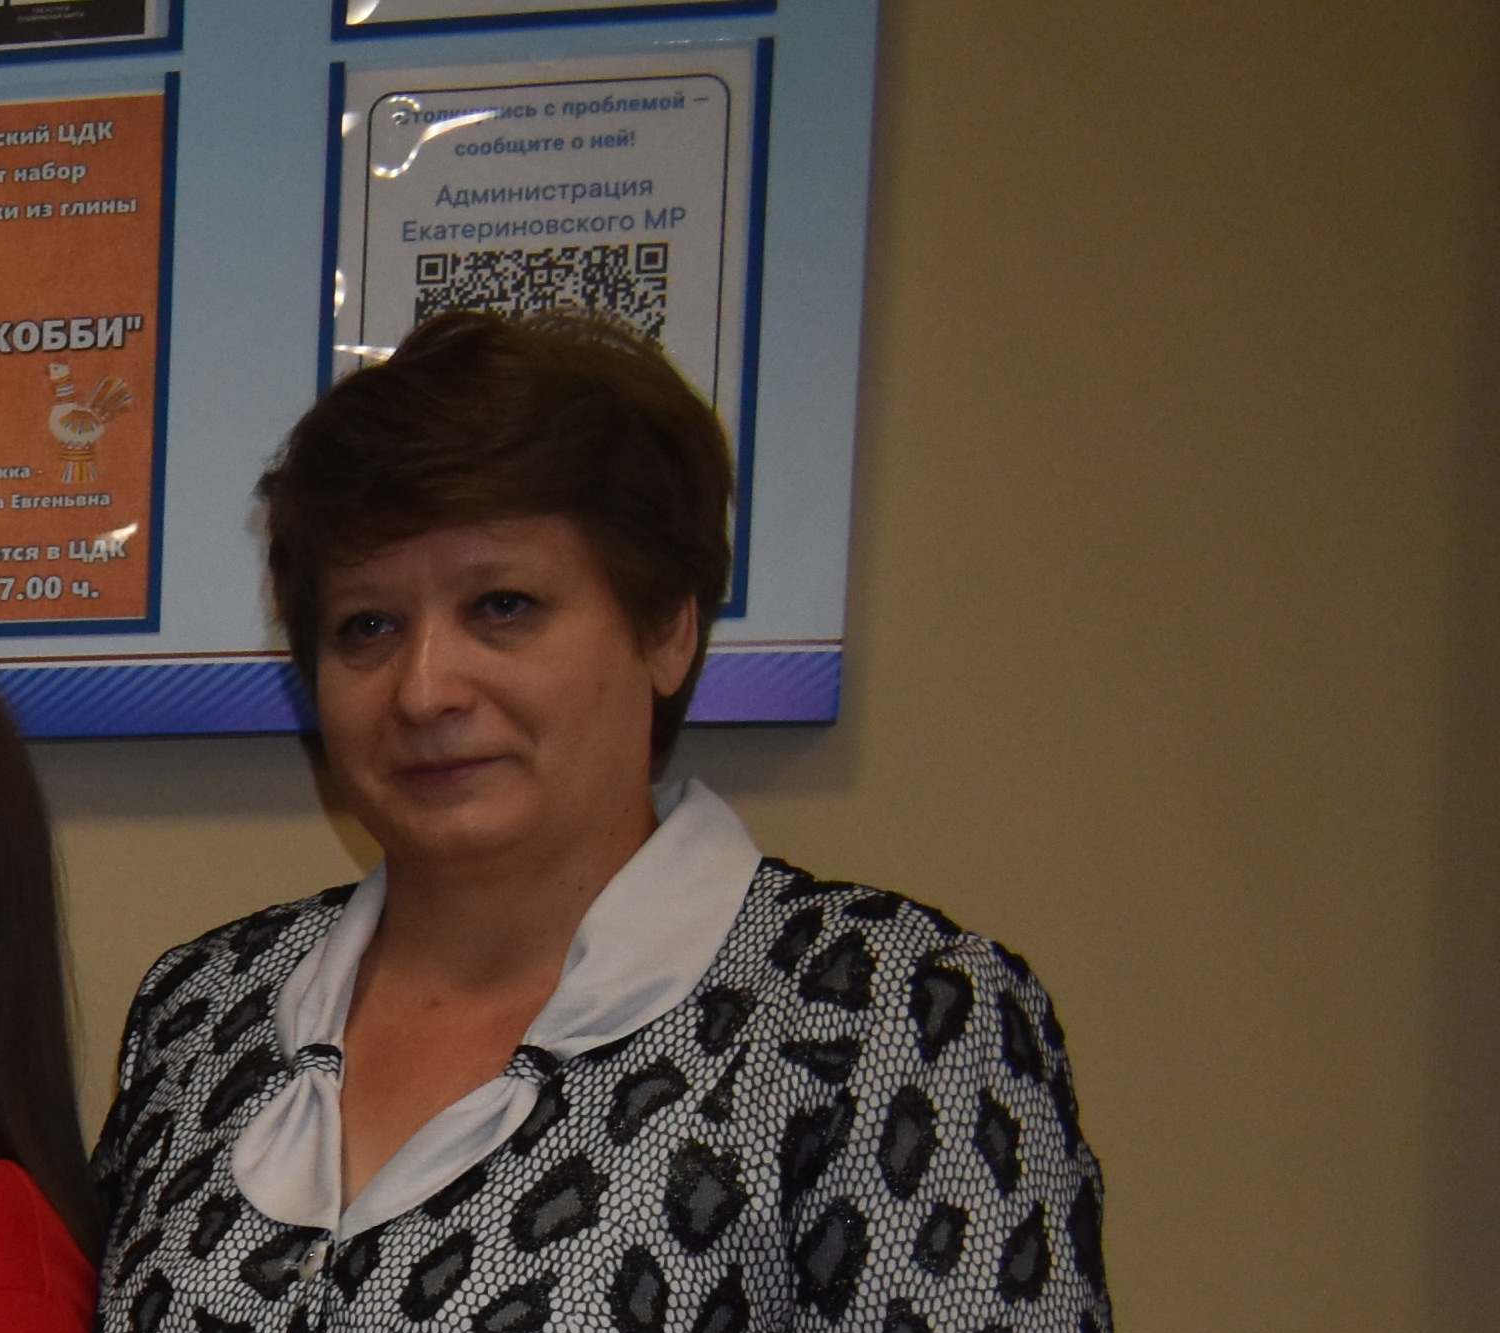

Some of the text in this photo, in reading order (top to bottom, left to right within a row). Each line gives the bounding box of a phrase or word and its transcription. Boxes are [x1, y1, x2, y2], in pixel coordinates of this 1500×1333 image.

[544, 102, 556, 117] с
[562, 92, 686, 119] проблемой
[57, 120, 113, 145] ЦДК
[454, 129, 636, 158] сообщите о ней!
[13, 161, 87, 185] набор
[436, 179, 654, 208] Администрация
[26, 203, 54, 219] из
[59, 198, 138, 216] глины
[402, 207, 687, 243] Екатериновского МР
[47, 546, 61, 560] в
[68, 538, 127, 564] ЦДК
[72, 582, 100, 599] ч.
